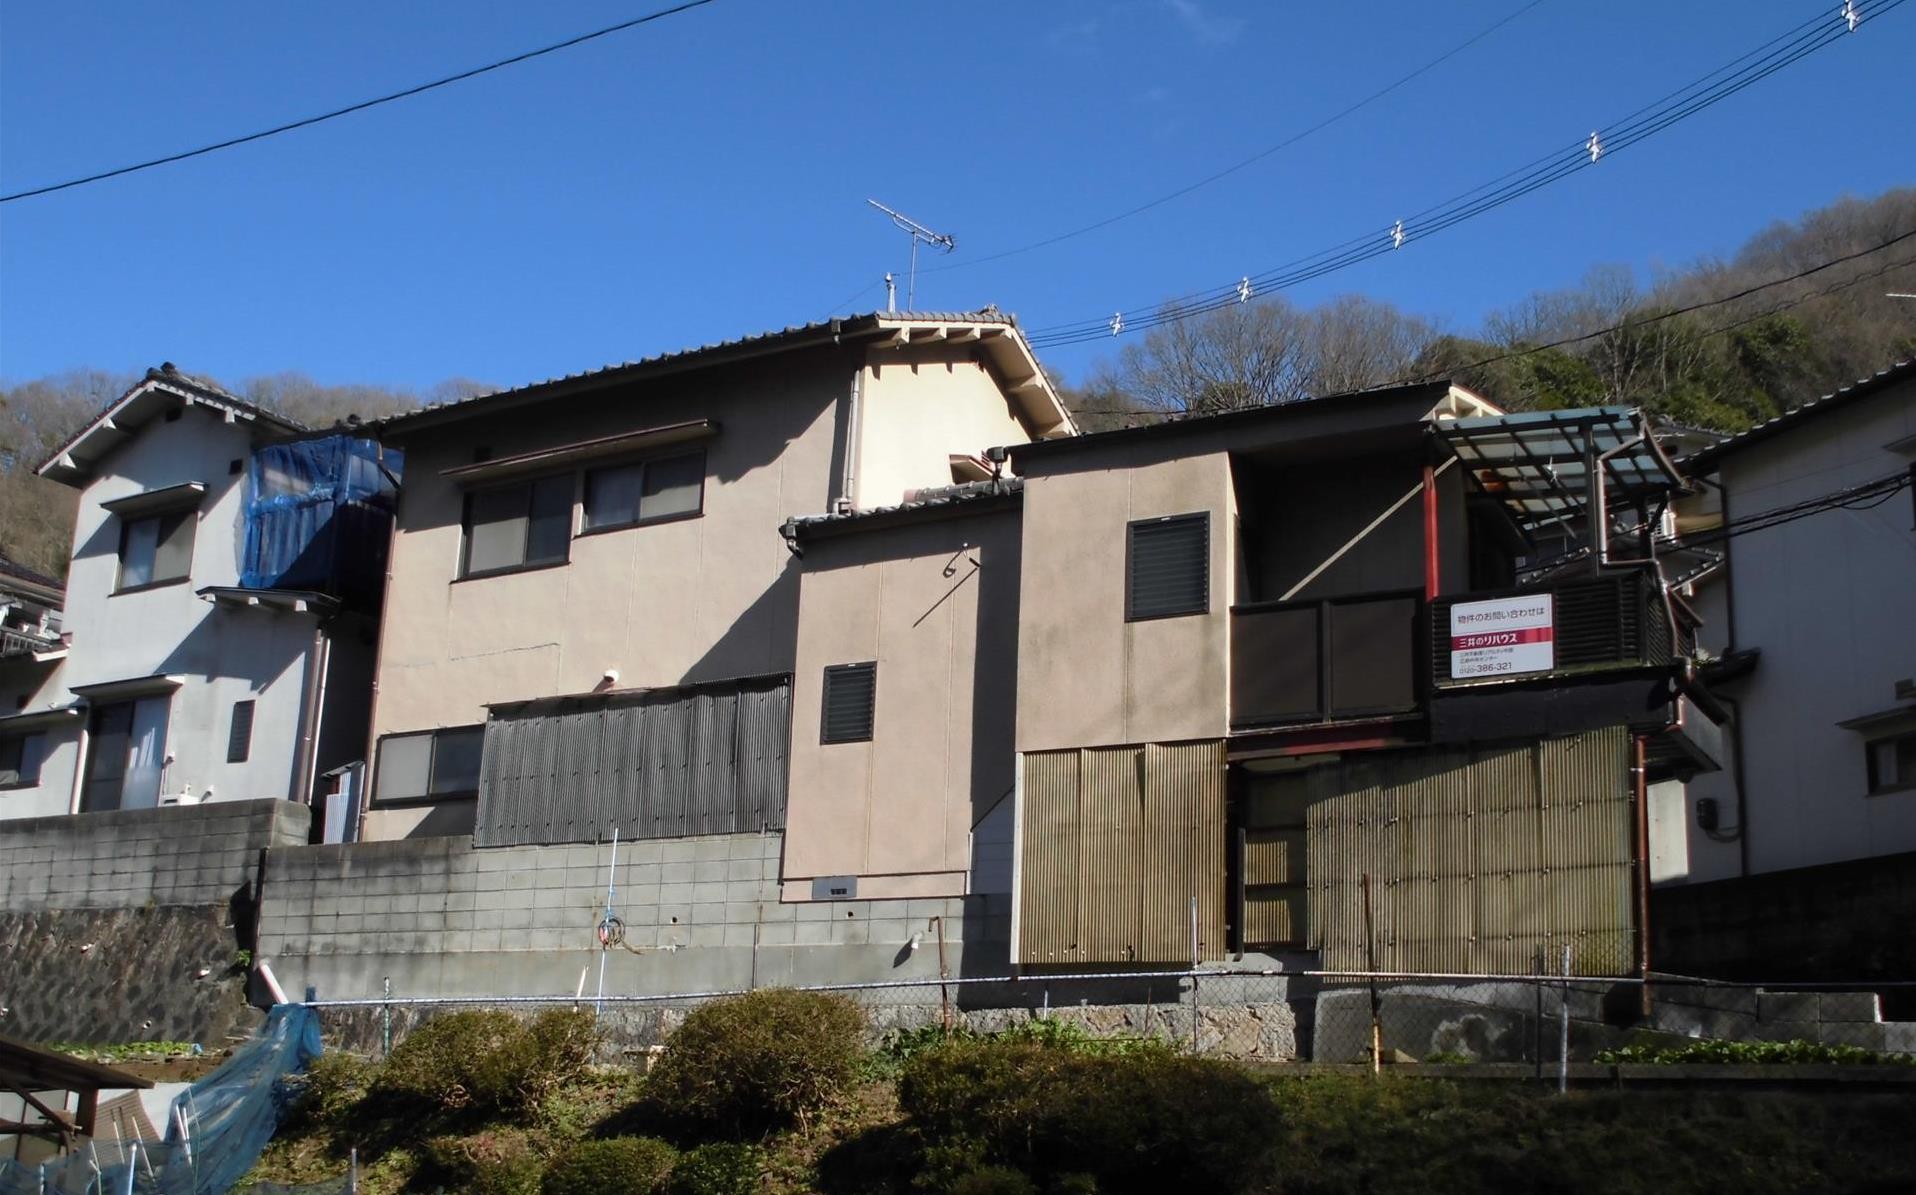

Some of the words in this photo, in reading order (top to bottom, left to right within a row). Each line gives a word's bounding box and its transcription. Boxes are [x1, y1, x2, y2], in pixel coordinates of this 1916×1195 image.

[1459, 633, 1518, 648] 三井のリハウス
